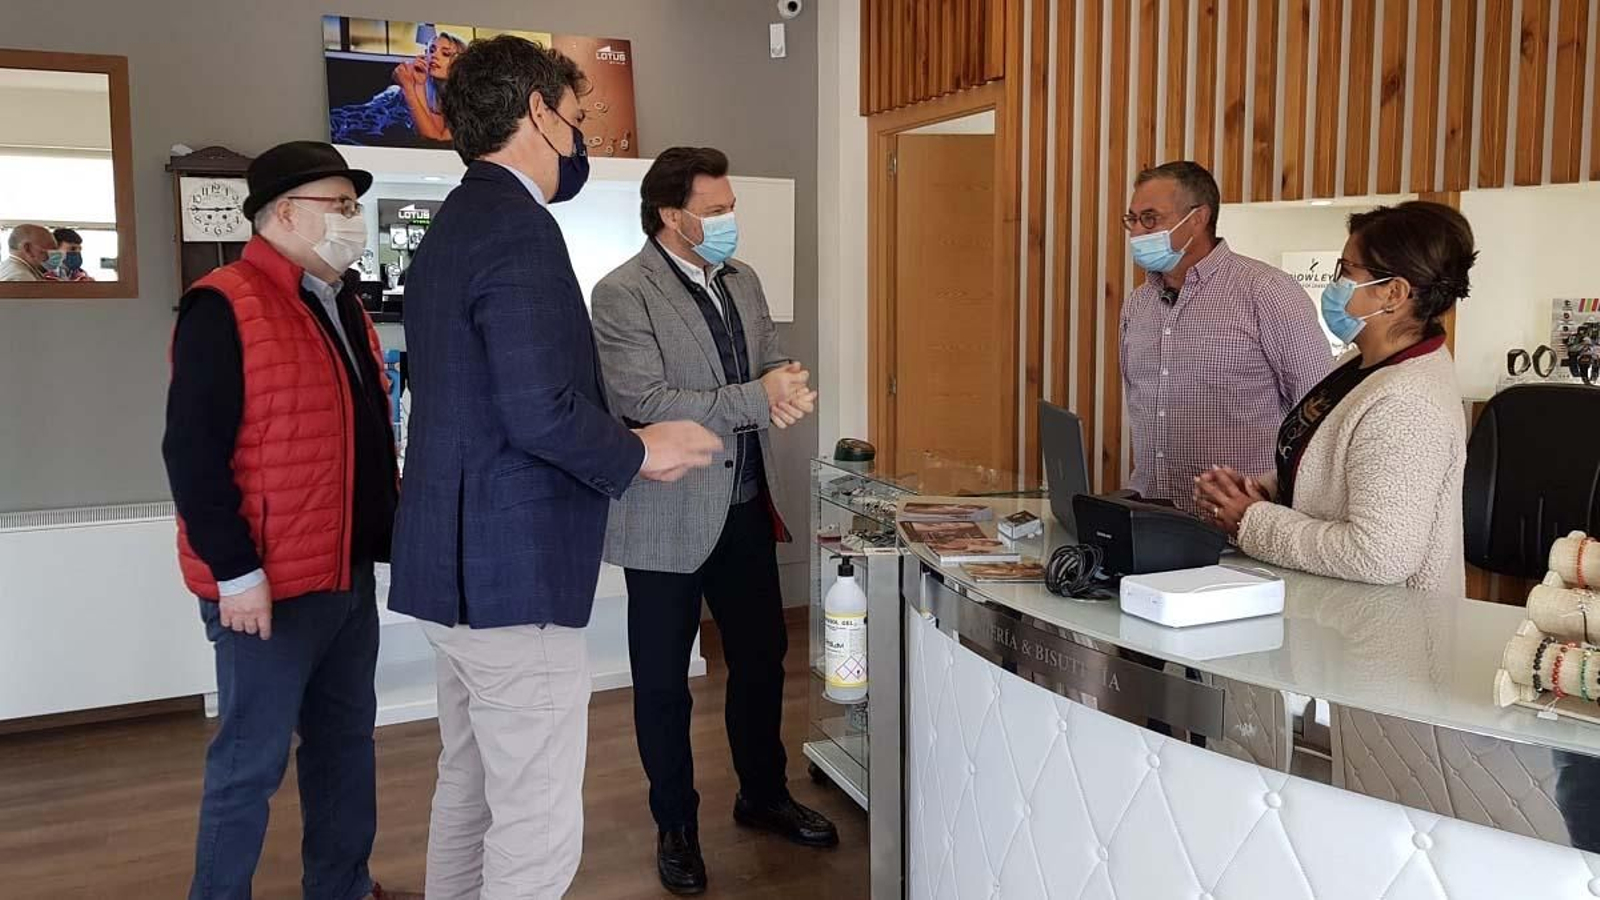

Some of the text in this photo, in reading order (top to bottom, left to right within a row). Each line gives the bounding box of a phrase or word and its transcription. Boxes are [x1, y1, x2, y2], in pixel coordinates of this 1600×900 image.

[596, 52, 626, 61] LOTUS
[211, 183, 221, 193] 12
[398, 211, 430, 219] LOTUS
[1021, 638, 1033, 657] &
